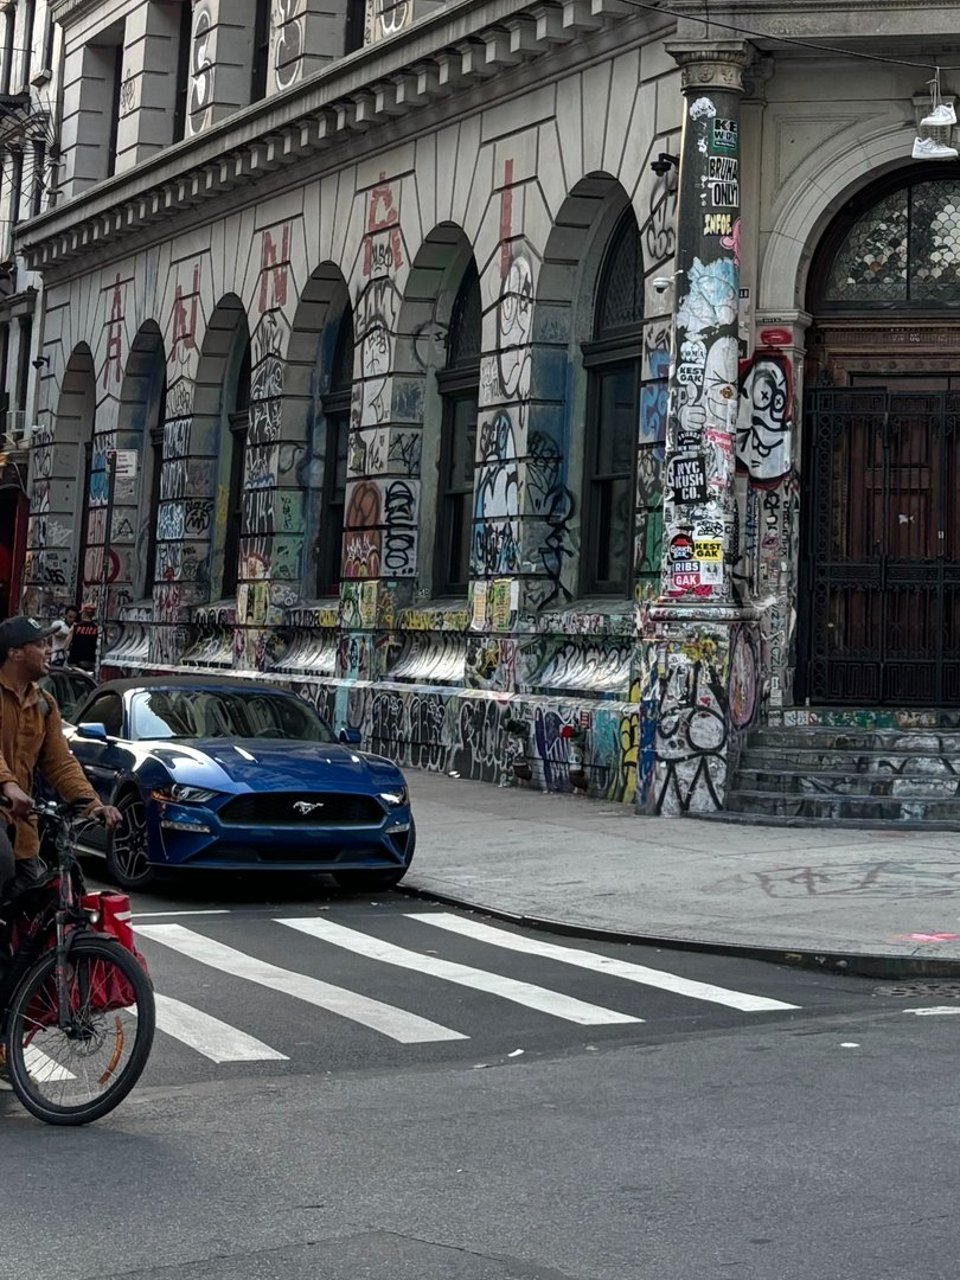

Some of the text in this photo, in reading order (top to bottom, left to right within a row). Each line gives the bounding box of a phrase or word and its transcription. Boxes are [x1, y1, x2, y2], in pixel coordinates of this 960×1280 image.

[676, 462, 701, 474] NYC
[675, 473, 704, 488] KUSH
[695, 543, 722, 551] KEST
[696, 550, 718, 558] GAK
[675, 561, 699, 572] RIBS
[675, 574, 698, 586] GAK
